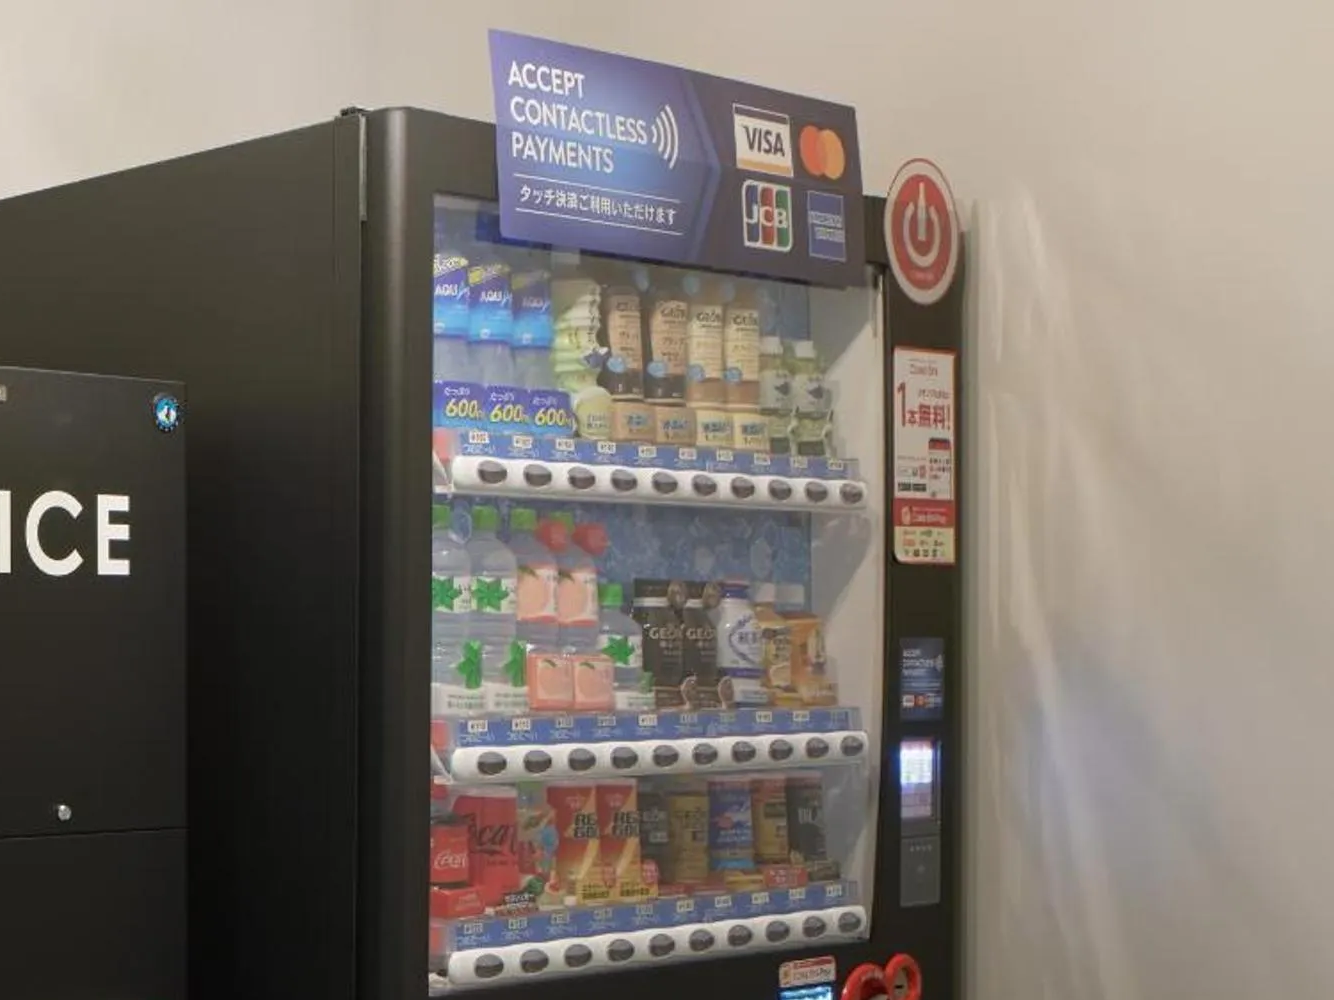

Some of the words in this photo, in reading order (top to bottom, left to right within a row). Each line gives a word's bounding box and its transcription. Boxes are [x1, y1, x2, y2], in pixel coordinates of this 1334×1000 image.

[508, 61, 585, 98] ACCEPT
[510, 96, 647, 146] CONTACTLESS
[743, 123, 785, 158] VISA
[511, 131, 614, 174] PAYMENTS
[519, 184, 677, 227] タッチ決済ご利用いただけます
[746, 202, 788, 231] JCB
